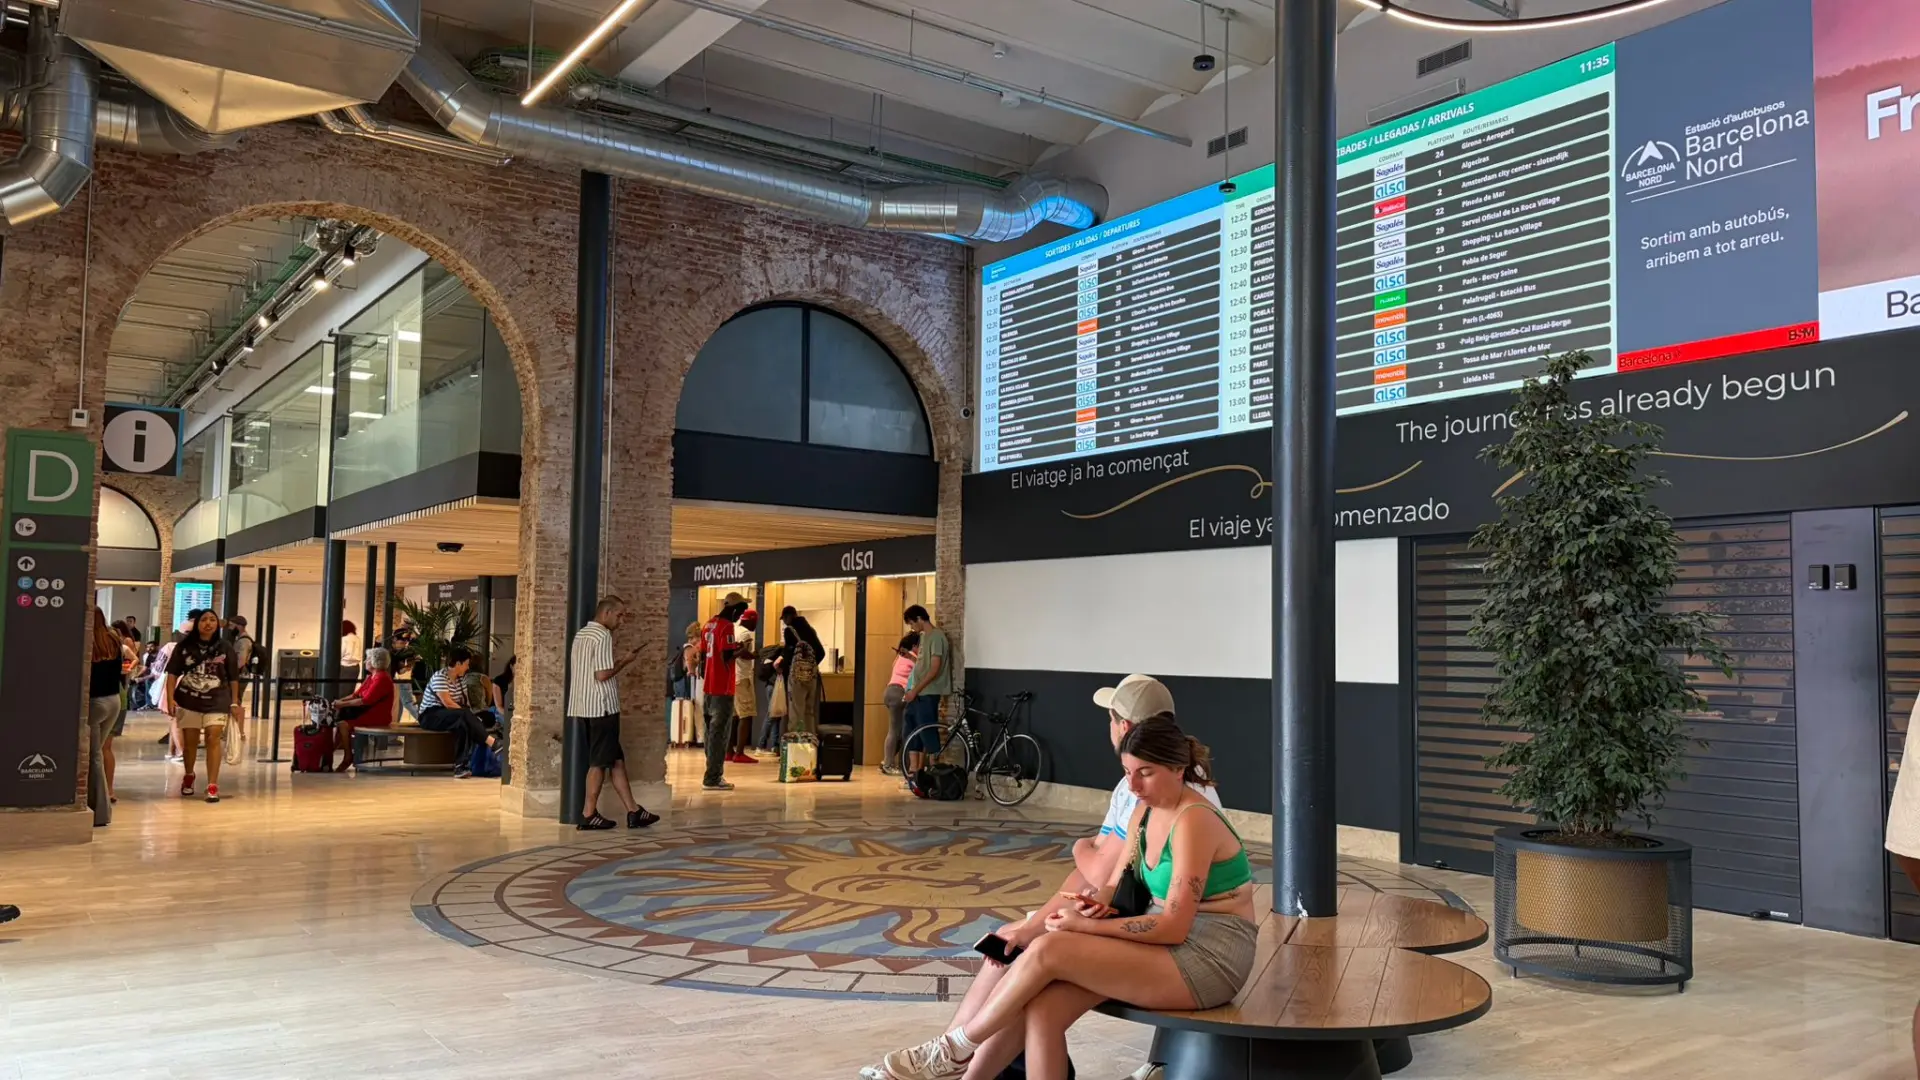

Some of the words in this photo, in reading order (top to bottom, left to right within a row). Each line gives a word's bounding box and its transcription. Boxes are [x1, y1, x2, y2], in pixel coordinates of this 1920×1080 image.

[1580, 54, 1610, 74] 11:35
[1685, 118, 1721, 136] Estació
[1722, 100, 1785, 125] d'autobusos
[1867, 85, 1920, 140] Fr
[1337, 140, 1367, 158] IBADES
[1368, 138, 1373, 147] /
[1374, 123, 1419, 144] LLEGADAS
[1421, 120, 1426, 129] /
[1428, 103, 1475, 127] ARRIVALS
[1435, 150, 1444, 159] 24
[1462, 139, 1482, 150] Girona
[1486, 127, 1515, 142] Aeroport
[1685, 109, 1810, 157] Barcelona
[1462, 173, 1498, 188] Amsterdam
[1498, 168, 1510, 178] city
[1510, 163, 1533, 174] center
[1537, 151, 1569, 167] sloterdijk
[1626, 162, 1676, 182] BARCELONA
[1686, 146, 1743, 181] Nord
[1376, 180, 1405, 198] alsa
[1462, 156, 1490, 169] Algeciras
[1638, 174, 1662, 188] NORD
[1436, 208, 1444, 216] 22
[1462, 197, 1483, 208] Pineda
[1484, 194, 1492, 202] de
[1492, 190, 1506, 200] Mar
[1436, 227, 1444, 235] 29
[1462, 217, 1481, 227] Servei
[1482, 210, 1502, 222] Oficial
[1521, 203, 1537, 212] Roca
[1538, 196, 1561, 208] Village
[1231, 212, 1248, 224] 12:25
[1640, 228, 1686, 250] Sortim
[1690, 221, 1721, 240] amb
[1725, 206, 1790, 231] autobús,
[1045, 243, 1071, 258] SORTIDES
[1075, 234, 1099, 248] SALIDAS
[1103, 219, 1141, 238] DEPARTURES
[1230, 229, 1248, 240] 12:30
[1436, 246, 1444, 254] 23
[1462, 235, 1491, 247] Shopping
[1504, 228, 1520, 237] Roca
[1520, 221, 1543, 233] Village
[1230, 246, 1248, 257] 12:30
[1646, 248, 1700, 269] arribem
[1704, 247, 1712, 257] a
[1716, 240, 1737, 254] tot
[1740, 233, 1784, 250] arreu.
[1230, 263, 1248, 274] 12:30
[1376, 274, 1405, 290] alsa
[1438, 265, 1442, 273] 1
[1480, 254, 1489, 262] de
[1489, 250, 1508, 261] Segur
[1500, 268, 1518, 277] Seine
[1230, 280, 1247, 290] 12:40
[1462, 292, 1496, 305] Palafrugell
[1524, 283, 1536, 292] Bus
[1230, 296, 1247, 307] 12:45
[1886, 290, 1920, 318] Ba
[1230, 314, 1247, 324] 12:50
[1230, 330, 1247, 340] 12:50
[1376, 330, 1405, 346] alsa
[1438, 323, 1443, 331] 2
[1230, 346, 1247, 357] 12:50
[1376, 348, 1405, 364] alsa
[1436, 342, 1445, 350] 33
[1438, 362, 1444, 370] 2
[1463, 356, 1480, 364] Tossa
[1490, 351, 1503, 360] Mar
[1508, 347, 1527, 357] Lloret
[1528, 346, 1536, 354] de
[1538, 343, 1552, 352] Mar
[1619, 352, 1672, 369] Barcelona
[1230, 364, 1246, 374] 12:55
[1229, 380, 1246, 391] 12:55
[1376, 386, 1405, 402] alsa
[1438, 381, 1444, 389] 3
[1396, 420, 1438, 443] The
[1600, 380, 1712, 417] already
[1722, 366, 1836, 400] begun
[28, 450, 79, 502] D
[1012, 472, 1023, 490] El
[1026, 468, 1066, 488] viatge
[1069, 464, 1082, 485] ja
[1086, 461, 1104, 479] ha
[1108, 449, 1189, 476] començat
[1335, 498, 1450, 527] menzado
[1190, 517, 1204, 538] El
[1209, 514, 1252, 540] viaje
[694, 556, 744, 581] moventis
[841, 549, 874, 571] alsa
